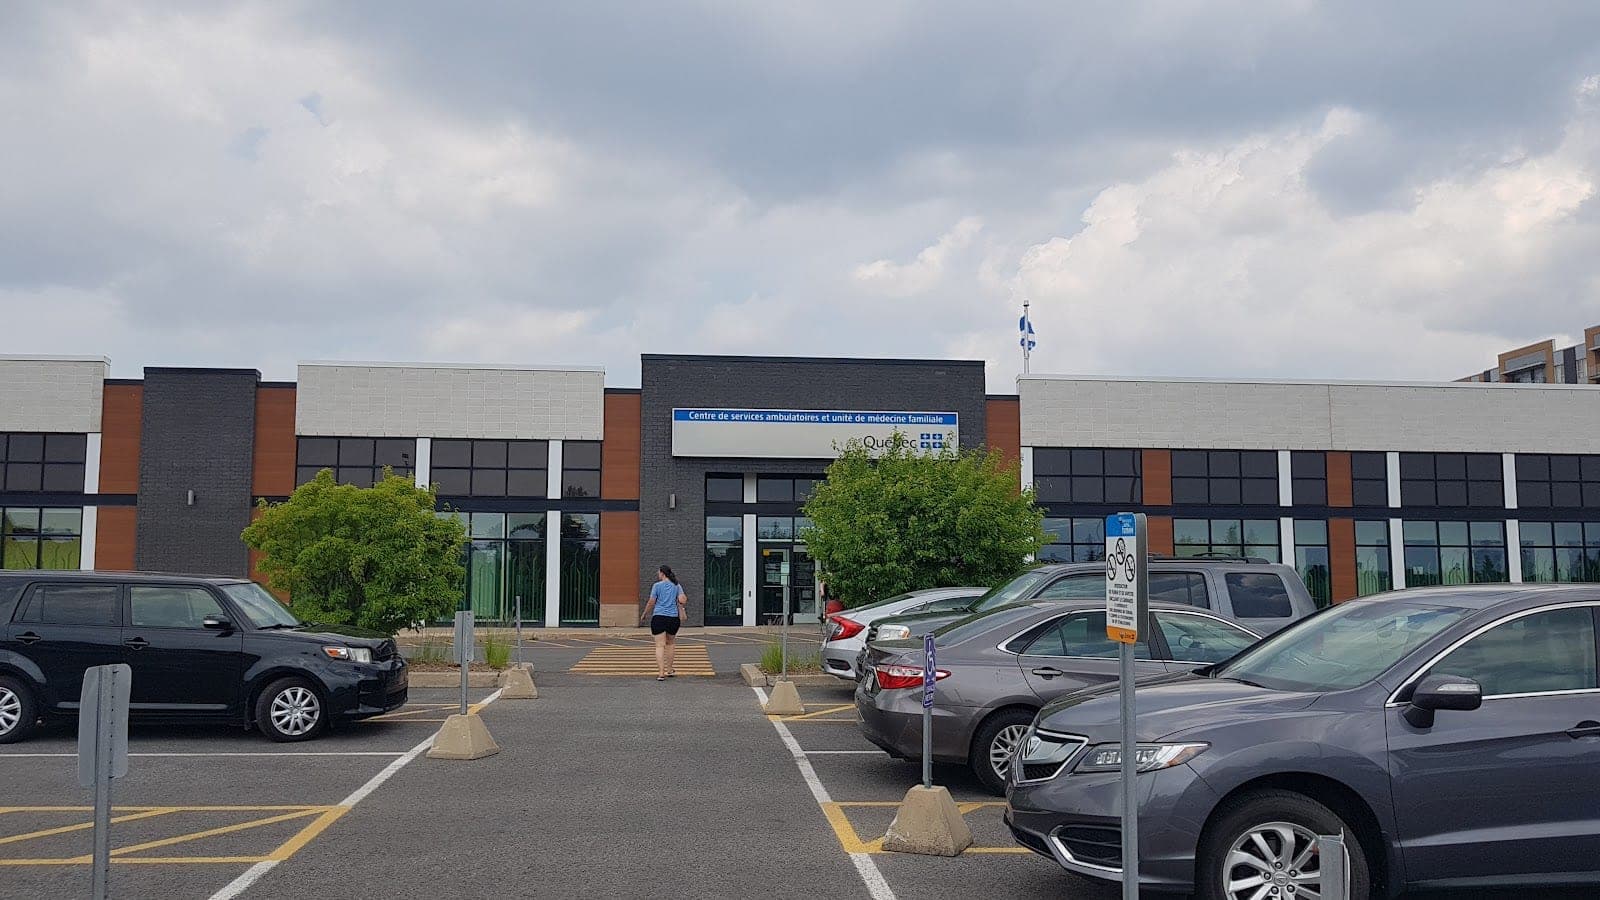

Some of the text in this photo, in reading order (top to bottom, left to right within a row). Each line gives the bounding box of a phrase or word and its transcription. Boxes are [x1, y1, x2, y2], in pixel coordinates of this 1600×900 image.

[689, 411, 944, 424] Centre de services ambulatoires et unité de médecine familiale
[863, 435, 917, 451] Quéec
